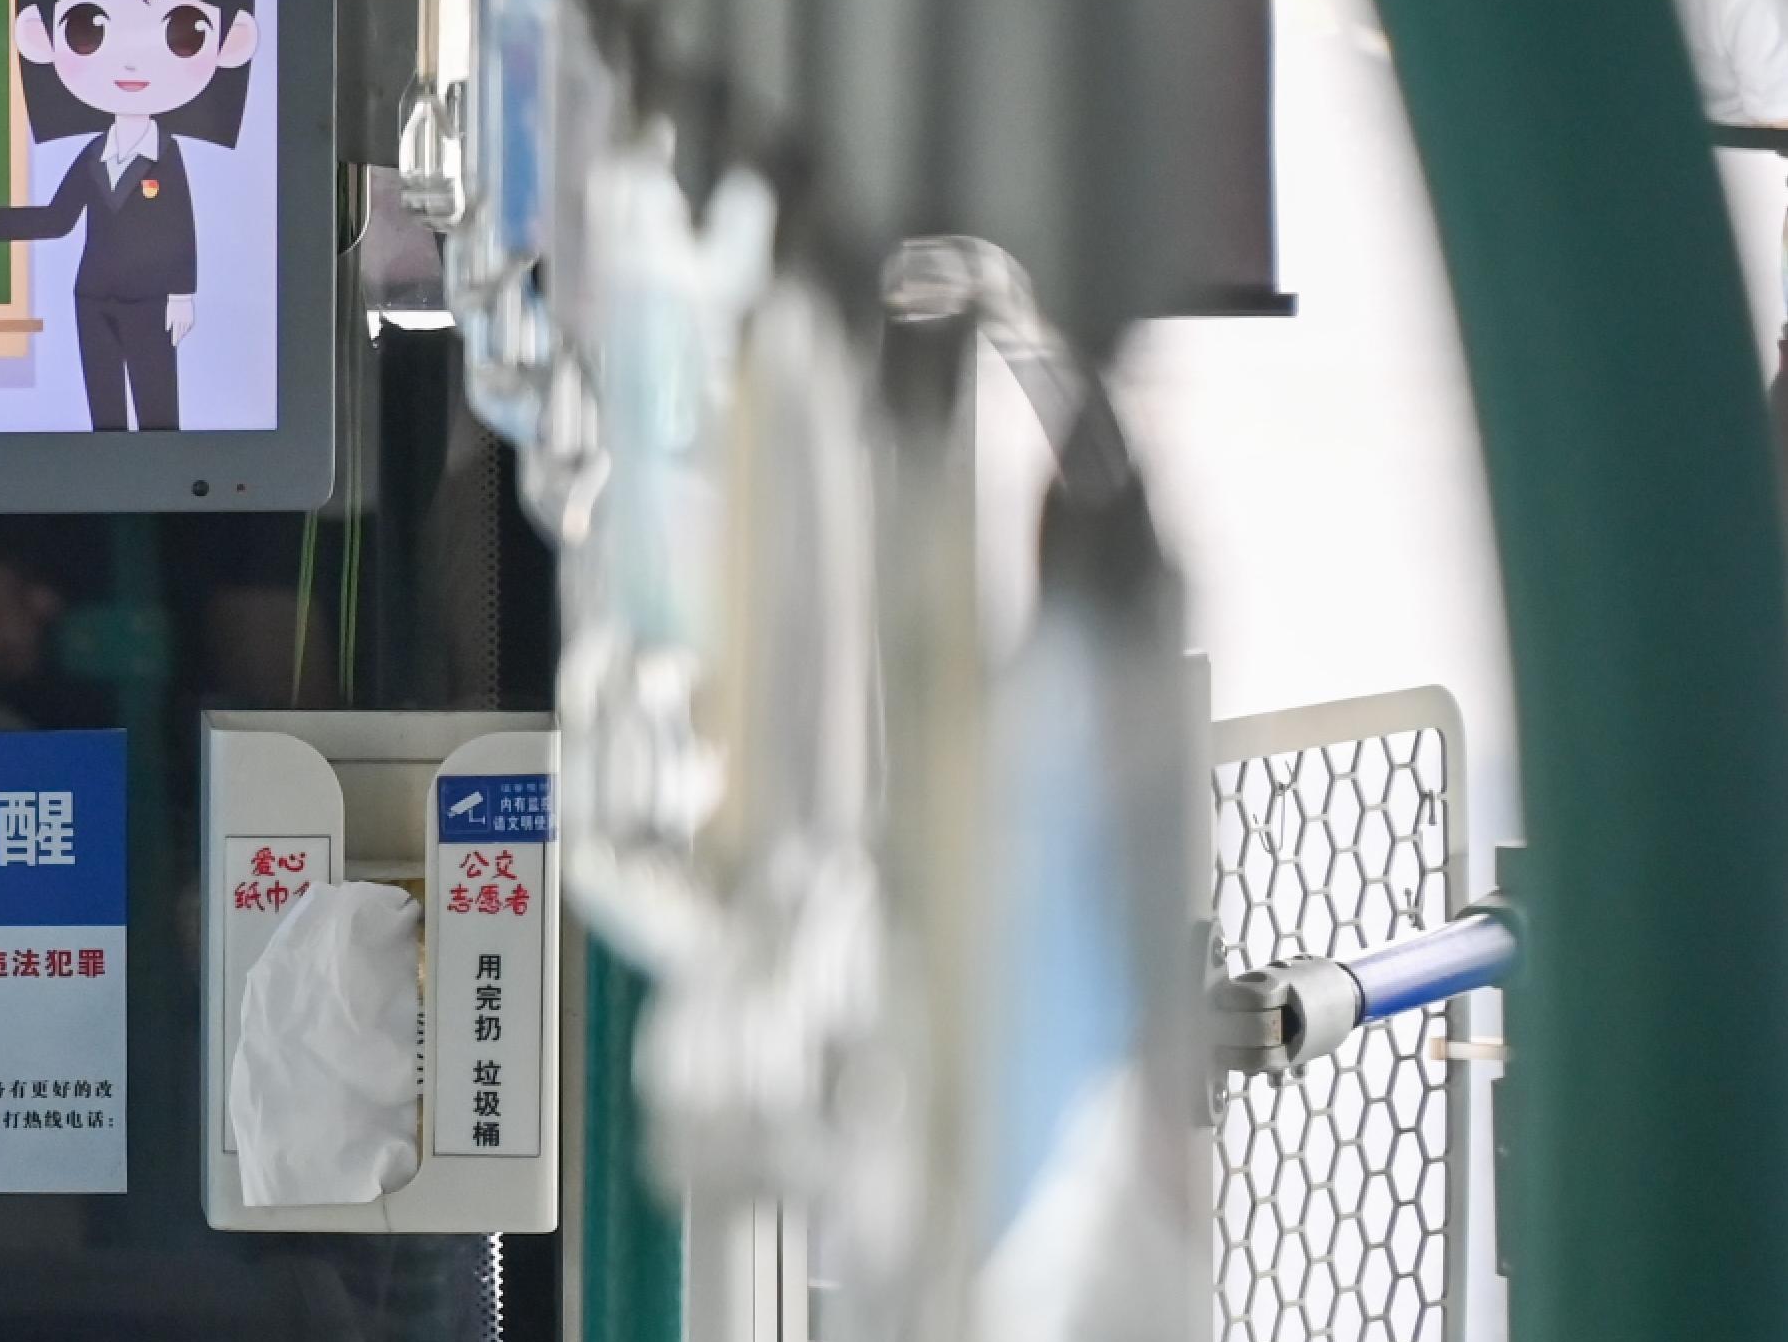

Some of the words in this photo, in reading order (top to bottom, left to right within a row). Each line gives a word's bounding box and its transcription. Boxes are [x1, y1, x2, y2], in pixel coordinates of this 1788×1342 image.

[250, 846, 306, 876] 爱心
[458, 849, 518, 880] 公交
[446, 883, 530, 916] 志愿者
[474, 954, 502, 1042] 用完扔
[472, 1060, 502, 1147] 垃圾桶
